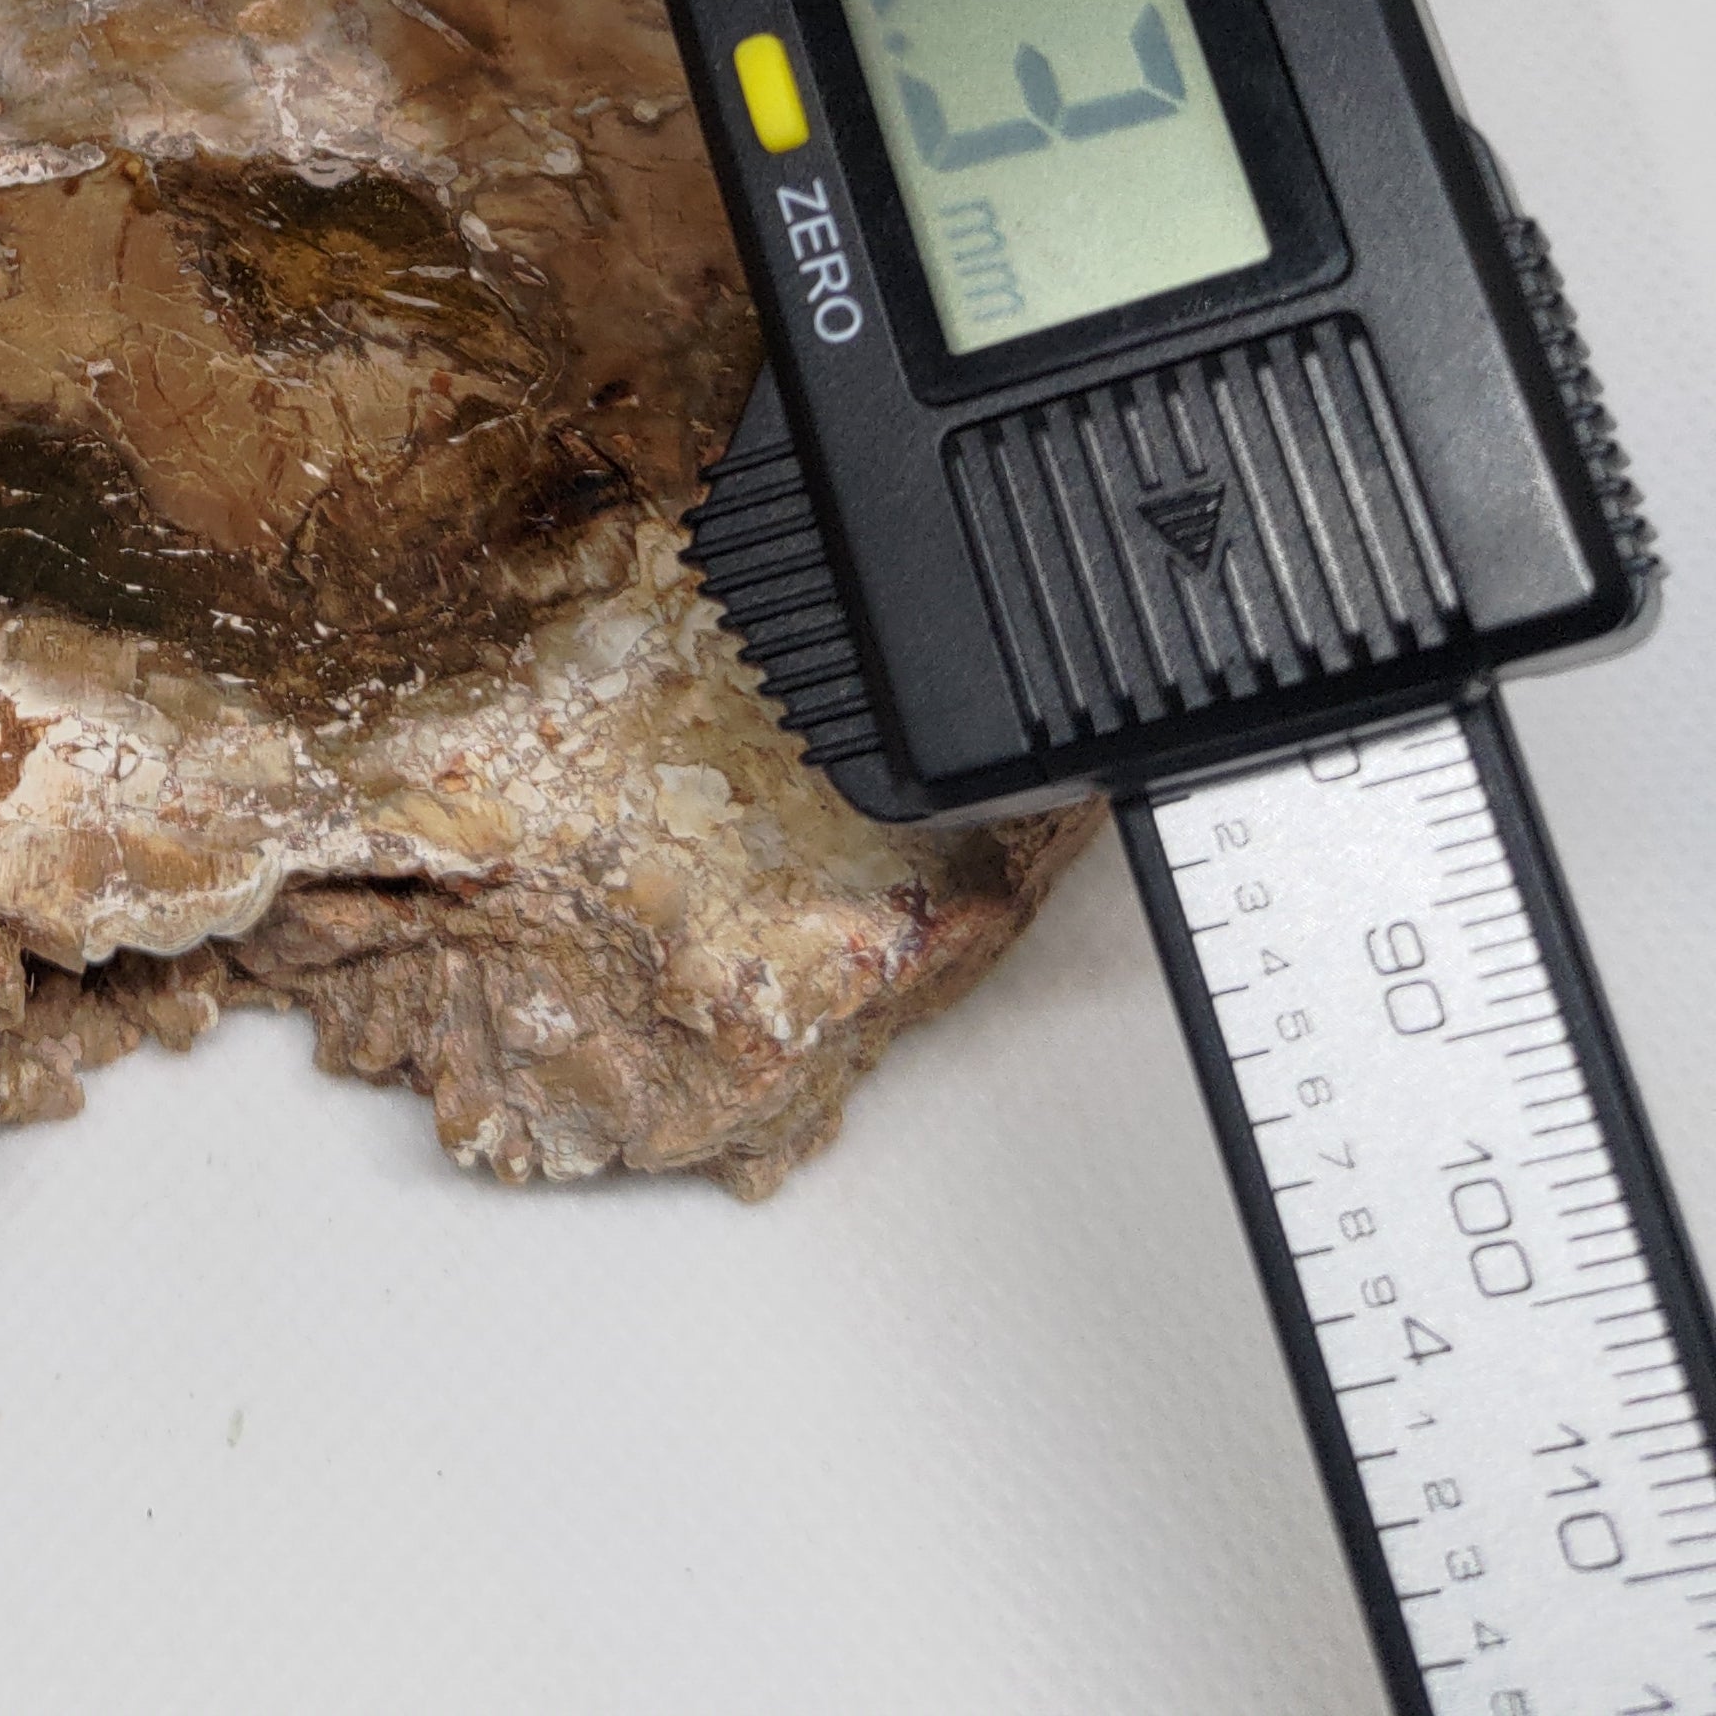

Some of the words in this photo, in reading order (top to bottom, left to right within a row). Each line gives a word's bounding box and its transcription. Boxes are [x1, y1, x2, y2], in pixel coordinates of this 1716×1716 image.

[775, 177, 865, 345] ZERO
[939, 196, 1026, 321] mm
[1213, 819, 1250, 851] 2
[1234, 879, 1271, 914] 3
[1260, 948, 1290, 978] 4
[1275, 1009, 1315, 1043] 5
[1317, 1140, 1357, 1172] 7
[1338, 1206, 1378, 1242] 8
[1364, 920, 1447, 1036] 90
[1440, 1140, 1534, 1299] 100
[1531, 1422, 1625, 1574] 110
[1403, 1314, 1454, 1366] 4
[1404, 1409, 1438, 1431] 1
[1444, 1544, 1486, 1582] 3
[1472, 1619, 1511, 1652] 4
